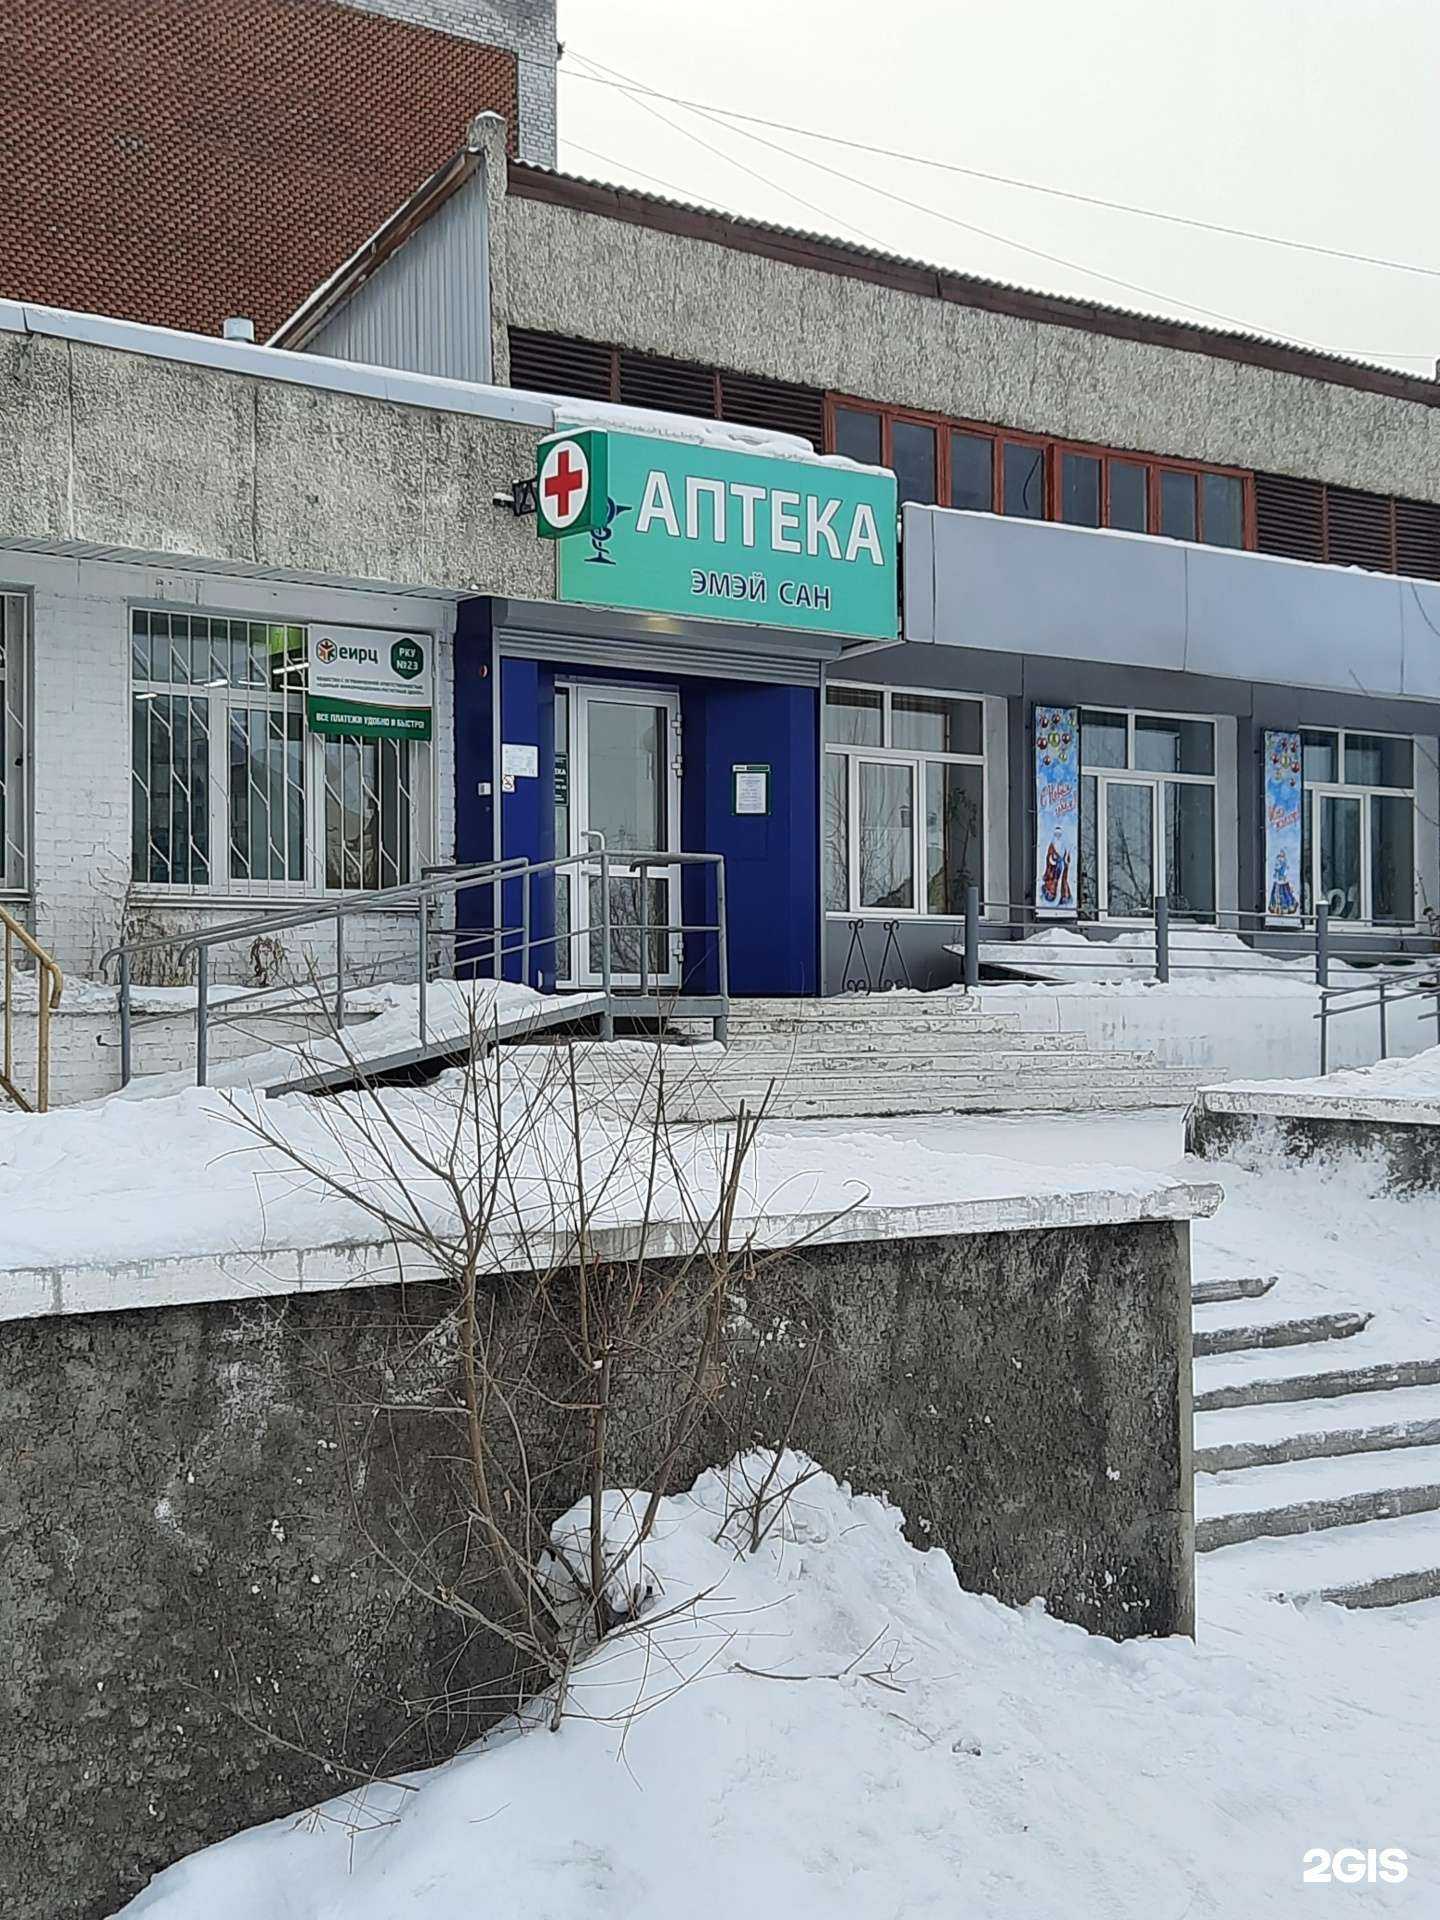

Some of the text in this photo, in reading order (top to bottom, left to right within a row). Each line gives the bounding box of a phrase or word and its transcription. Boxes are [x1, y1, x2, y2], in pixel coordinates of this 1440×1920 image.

[635, 470, 885, 566] АПТЕКА
[691, 568, 832, 611] ЭМЭЙ САН
[340, 646, 378, 664] еирц
[399, 647, 416, 658] РКУ
